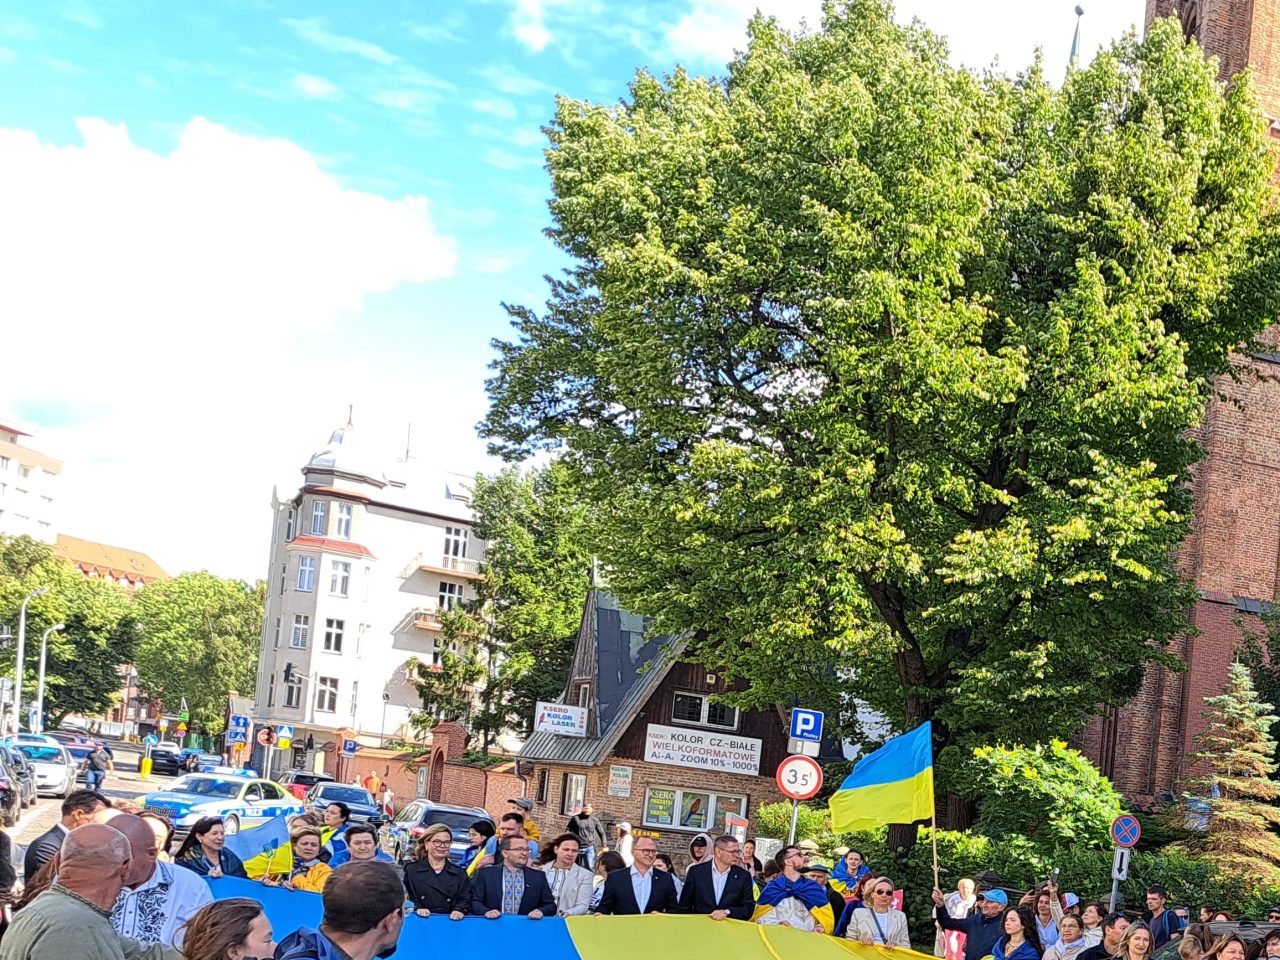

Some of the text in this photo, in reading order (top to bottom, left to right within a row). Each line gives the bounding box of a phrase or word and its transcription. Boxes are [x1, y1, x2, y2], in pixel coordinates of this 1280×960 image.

[543, 706, 569, 714] KSERO
[547, 713, 573, 721] KOLOR
[552, 720, 576, 728] LASER
[795, 712, 815, 736] P
[670, 733, 704, 745] KOLOR
[652, 741, 757, 762] WIELKOFORMATOWE
[680, 754, 709, 765] ZOOM
[649, 789, 675, 800] KSERO
